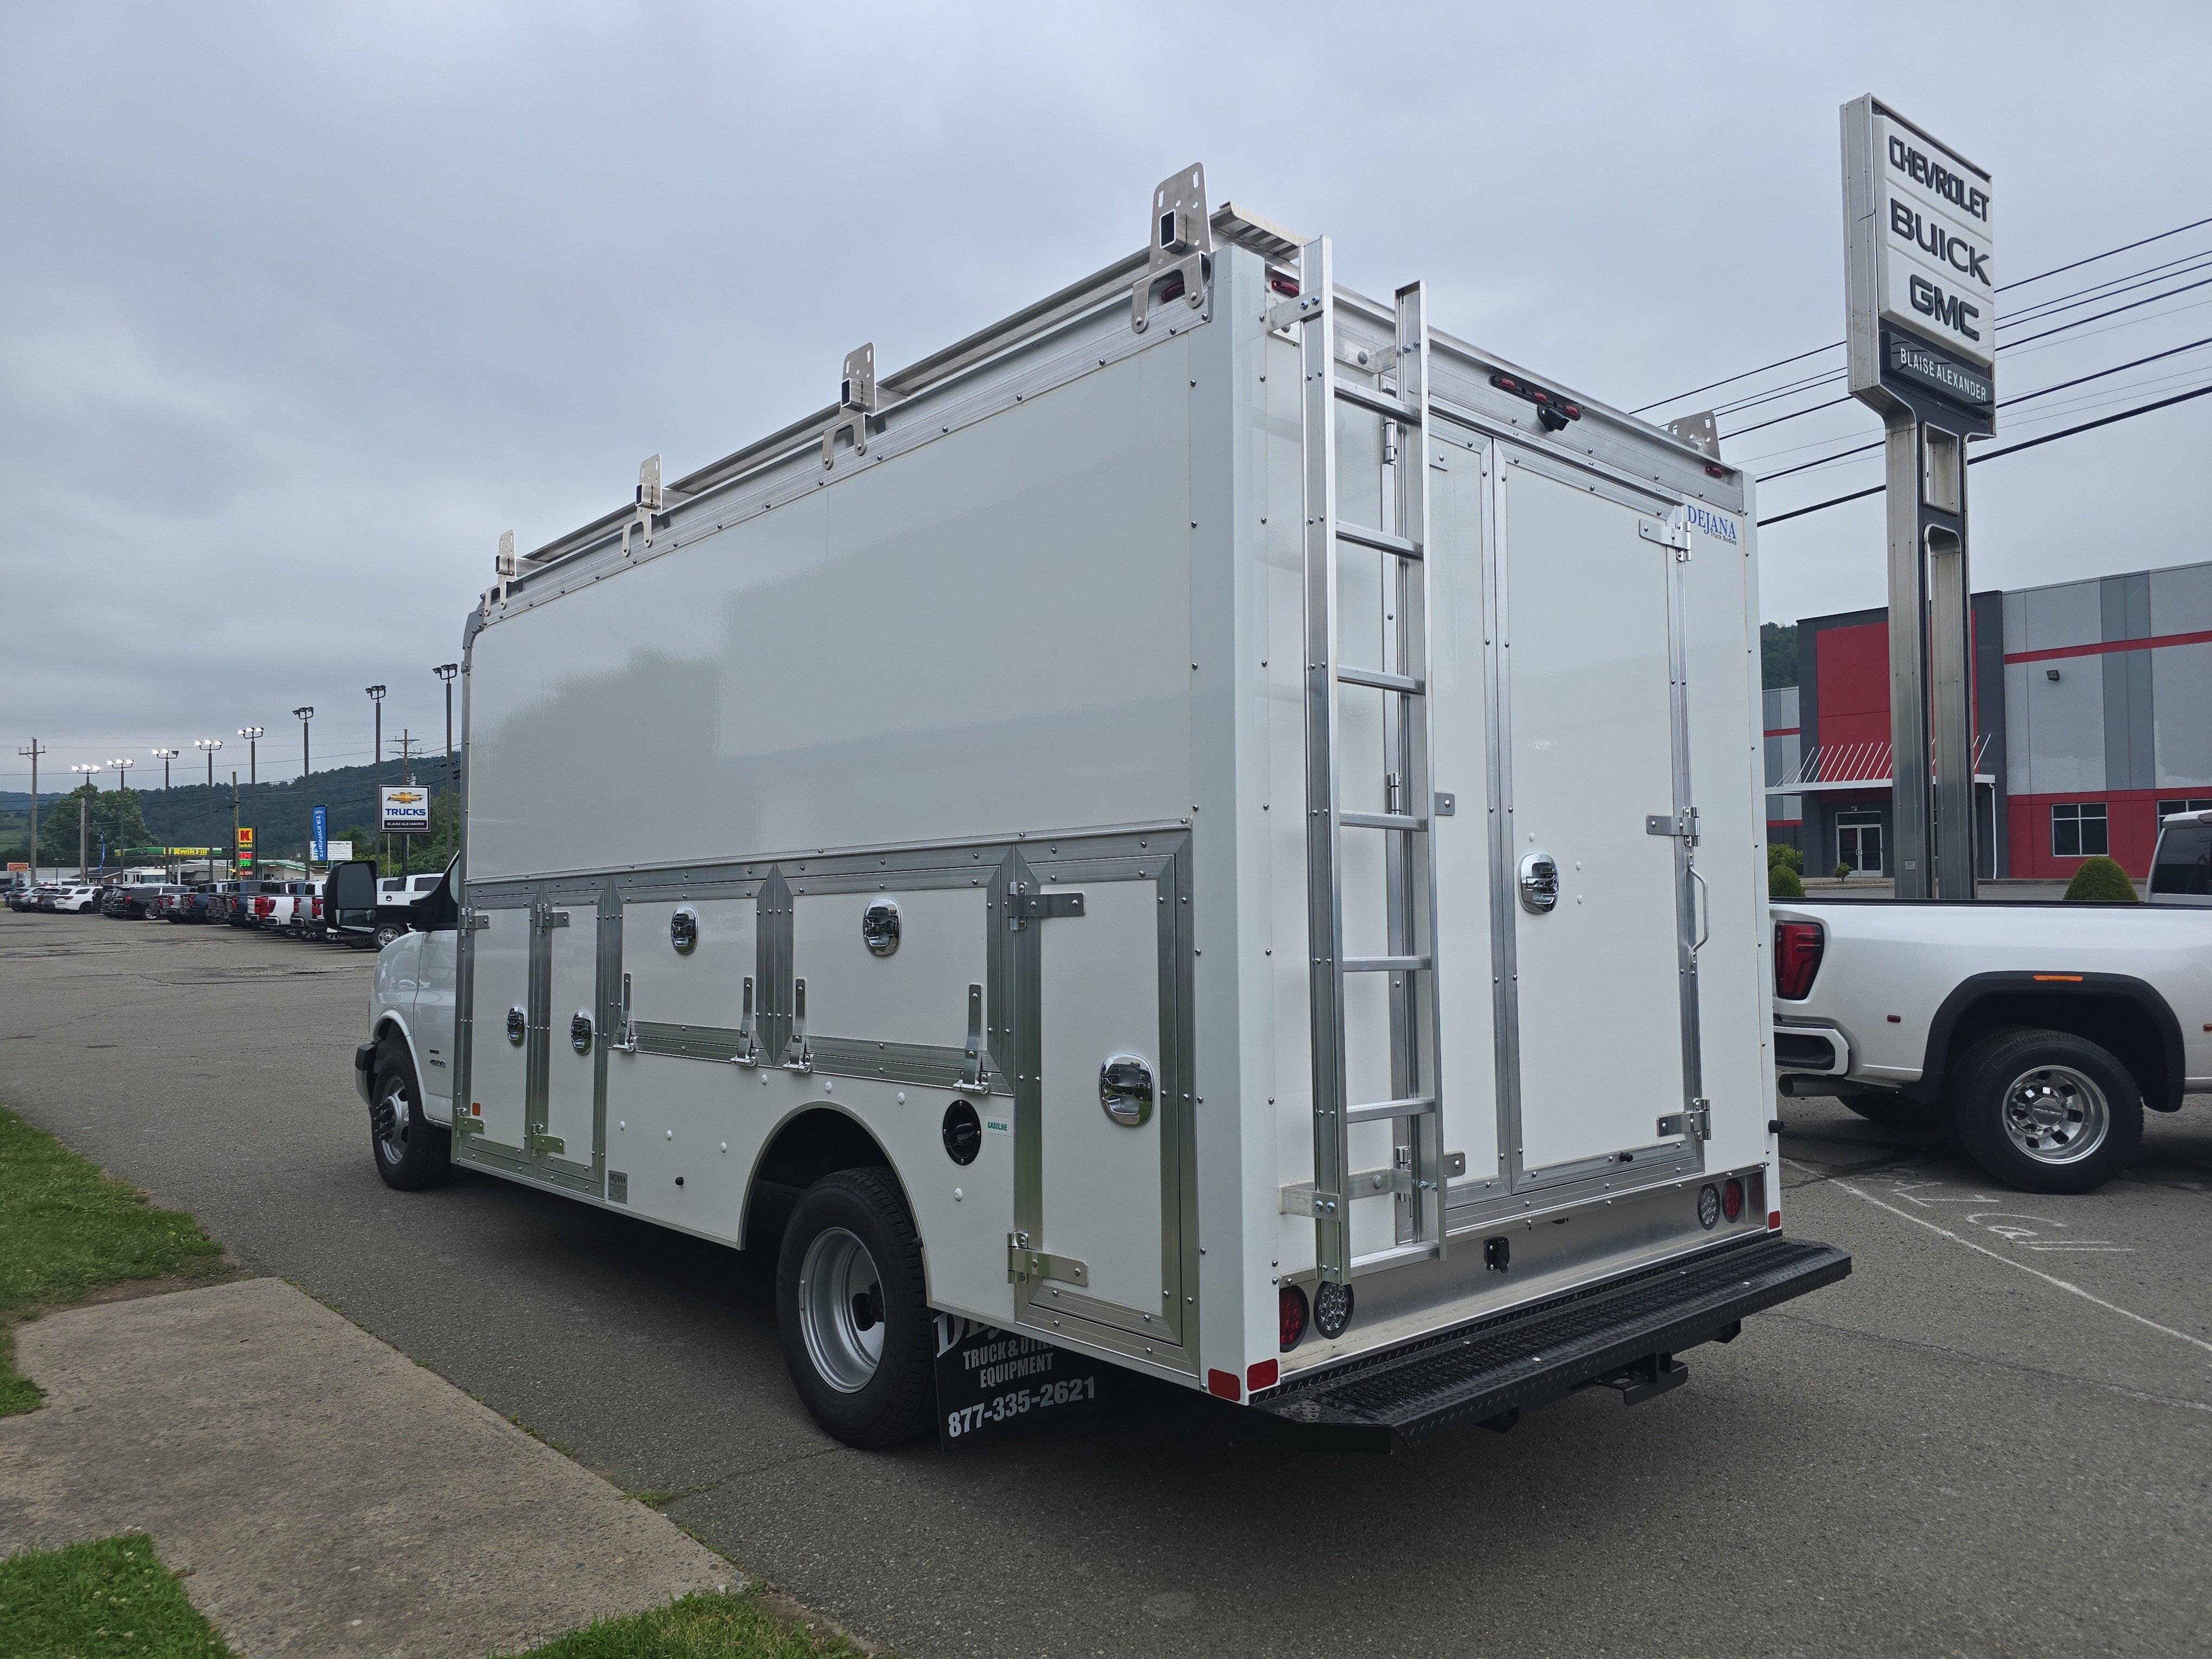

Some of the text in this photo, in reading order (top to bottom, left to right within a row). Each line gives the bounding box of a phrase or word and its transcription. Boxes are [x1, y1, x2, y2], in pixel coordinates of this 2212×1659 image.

[1889, 134, 1990, 222] CHEVROLET
[1891, 197, 1991, 287] BUICK
[1909, 274, 1980, 342] GMC
[1900, 348, 1986, 402] BLAISE ALEXANDER
[1687, 504, 1737, 539] DEJANA
[1710, 531, 1722, 540] Truck
[240, 830, 251, 841] K
[987, 1121, 1008, 1131] GASOLINE
[609, 1174, 626, 1184] DEJANA
[962, 1341, 1007, 1369] TRUCK
[1007, 1339, 1019, 1357] &
[980, 1352, 1053, 1388] EQUIPMENT
[948, 1376, 1095, 1438] 877-335-2621
